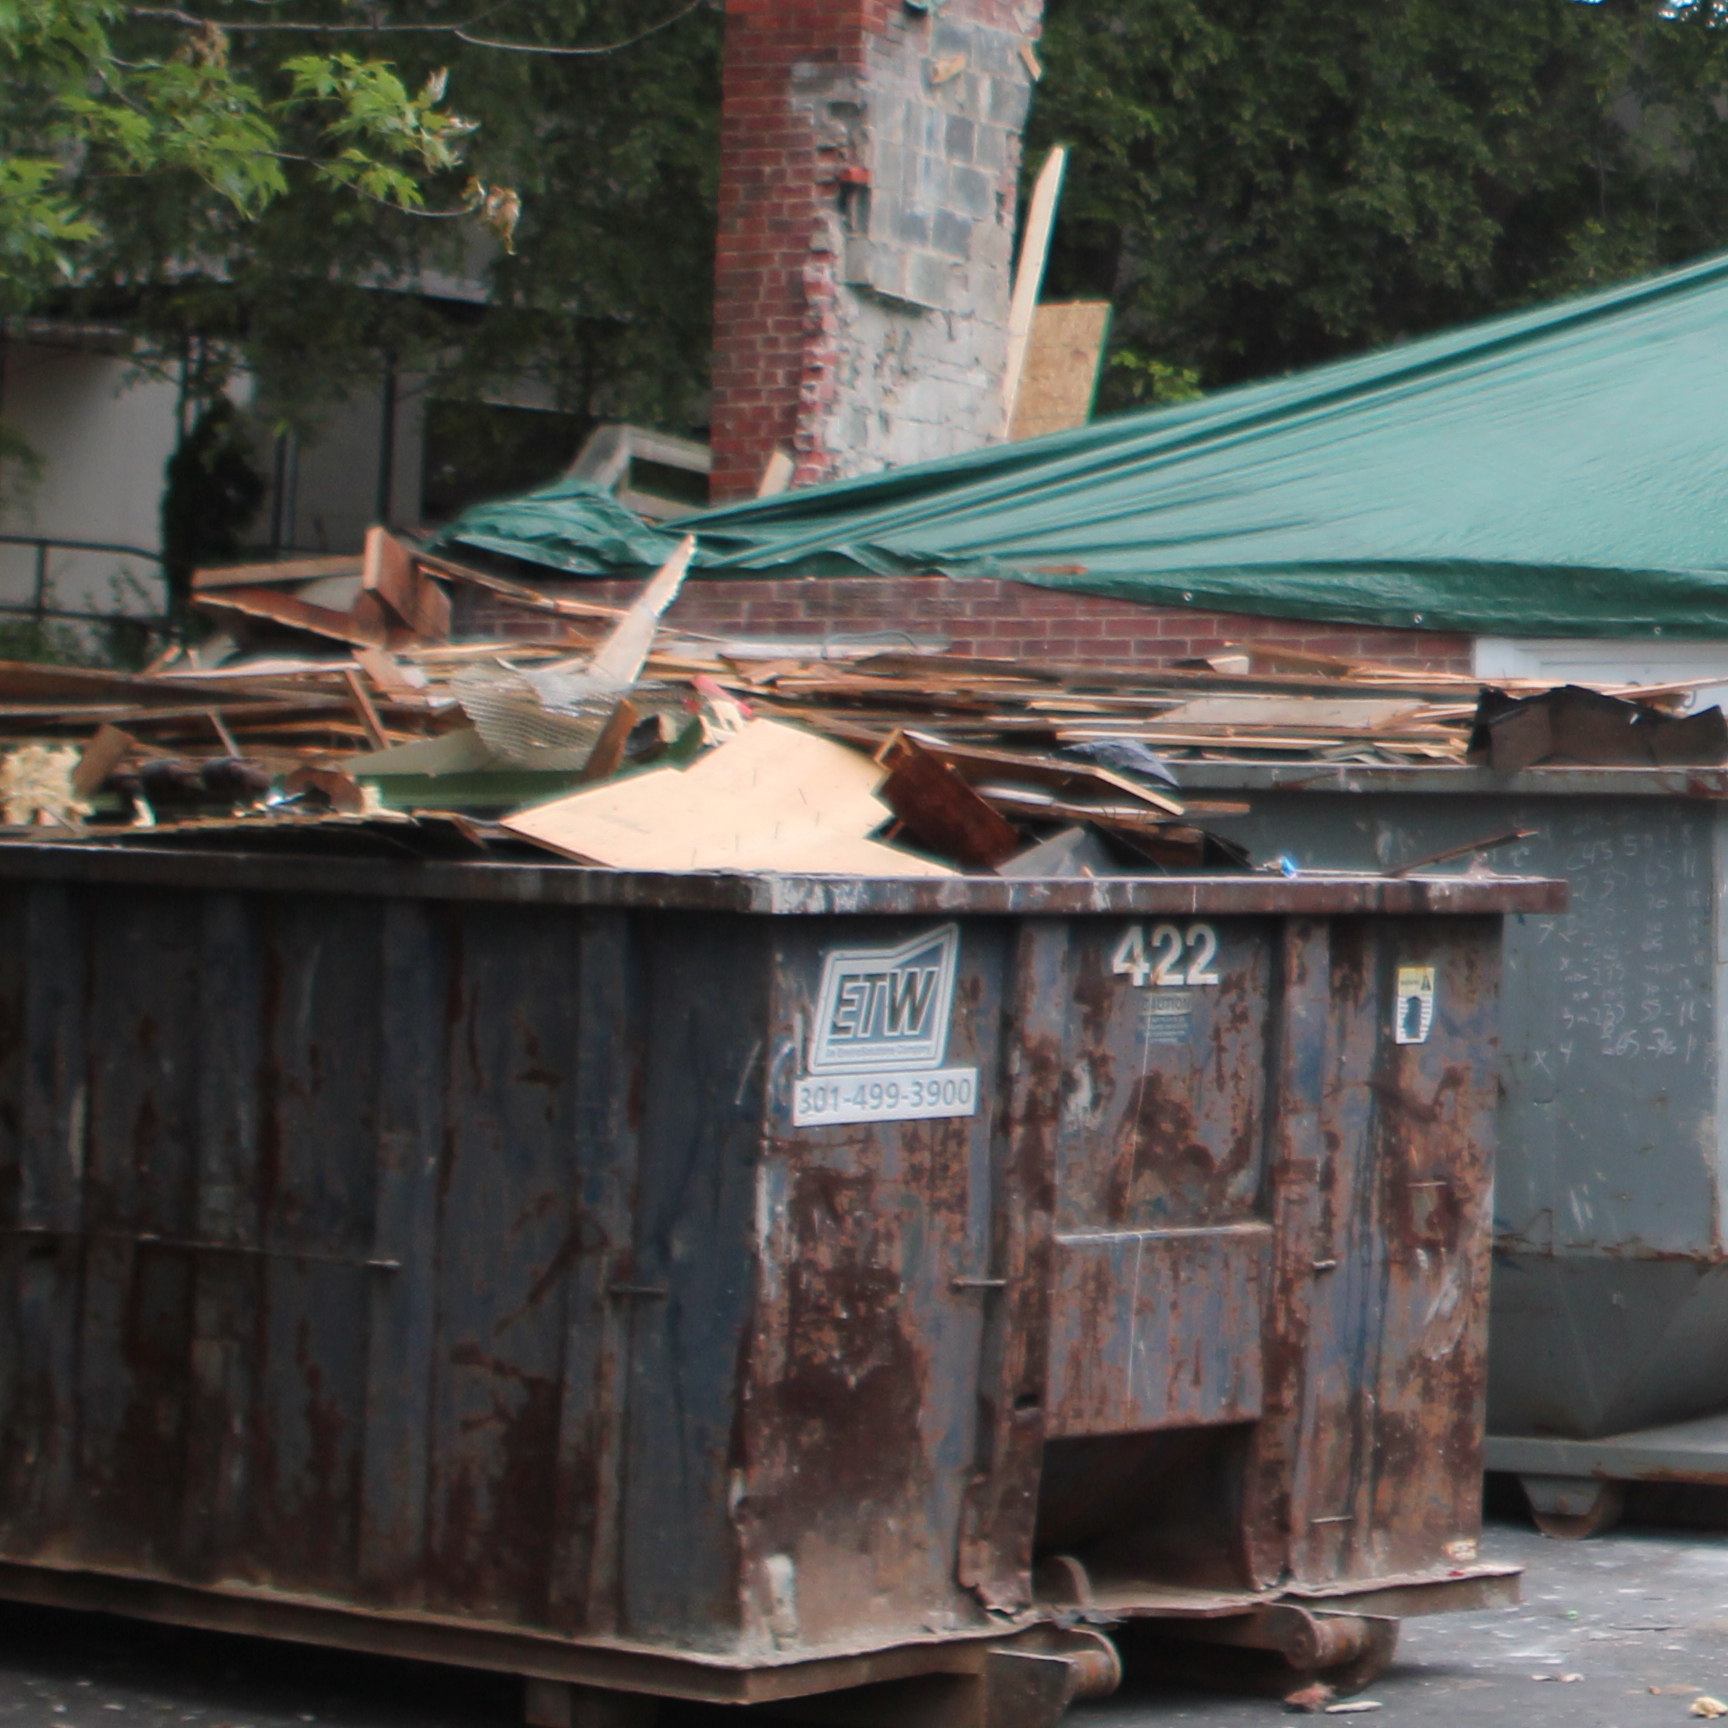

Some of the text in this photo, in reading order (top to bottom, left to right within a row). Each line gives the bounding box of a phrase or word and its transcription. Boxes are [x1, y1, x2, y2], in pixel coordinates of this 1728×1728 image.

[1112, 923, 1219, 986] 422
[827, 967, 941, 1040] ETW
[798, 1078, 972, 1114] 301-499-3900
